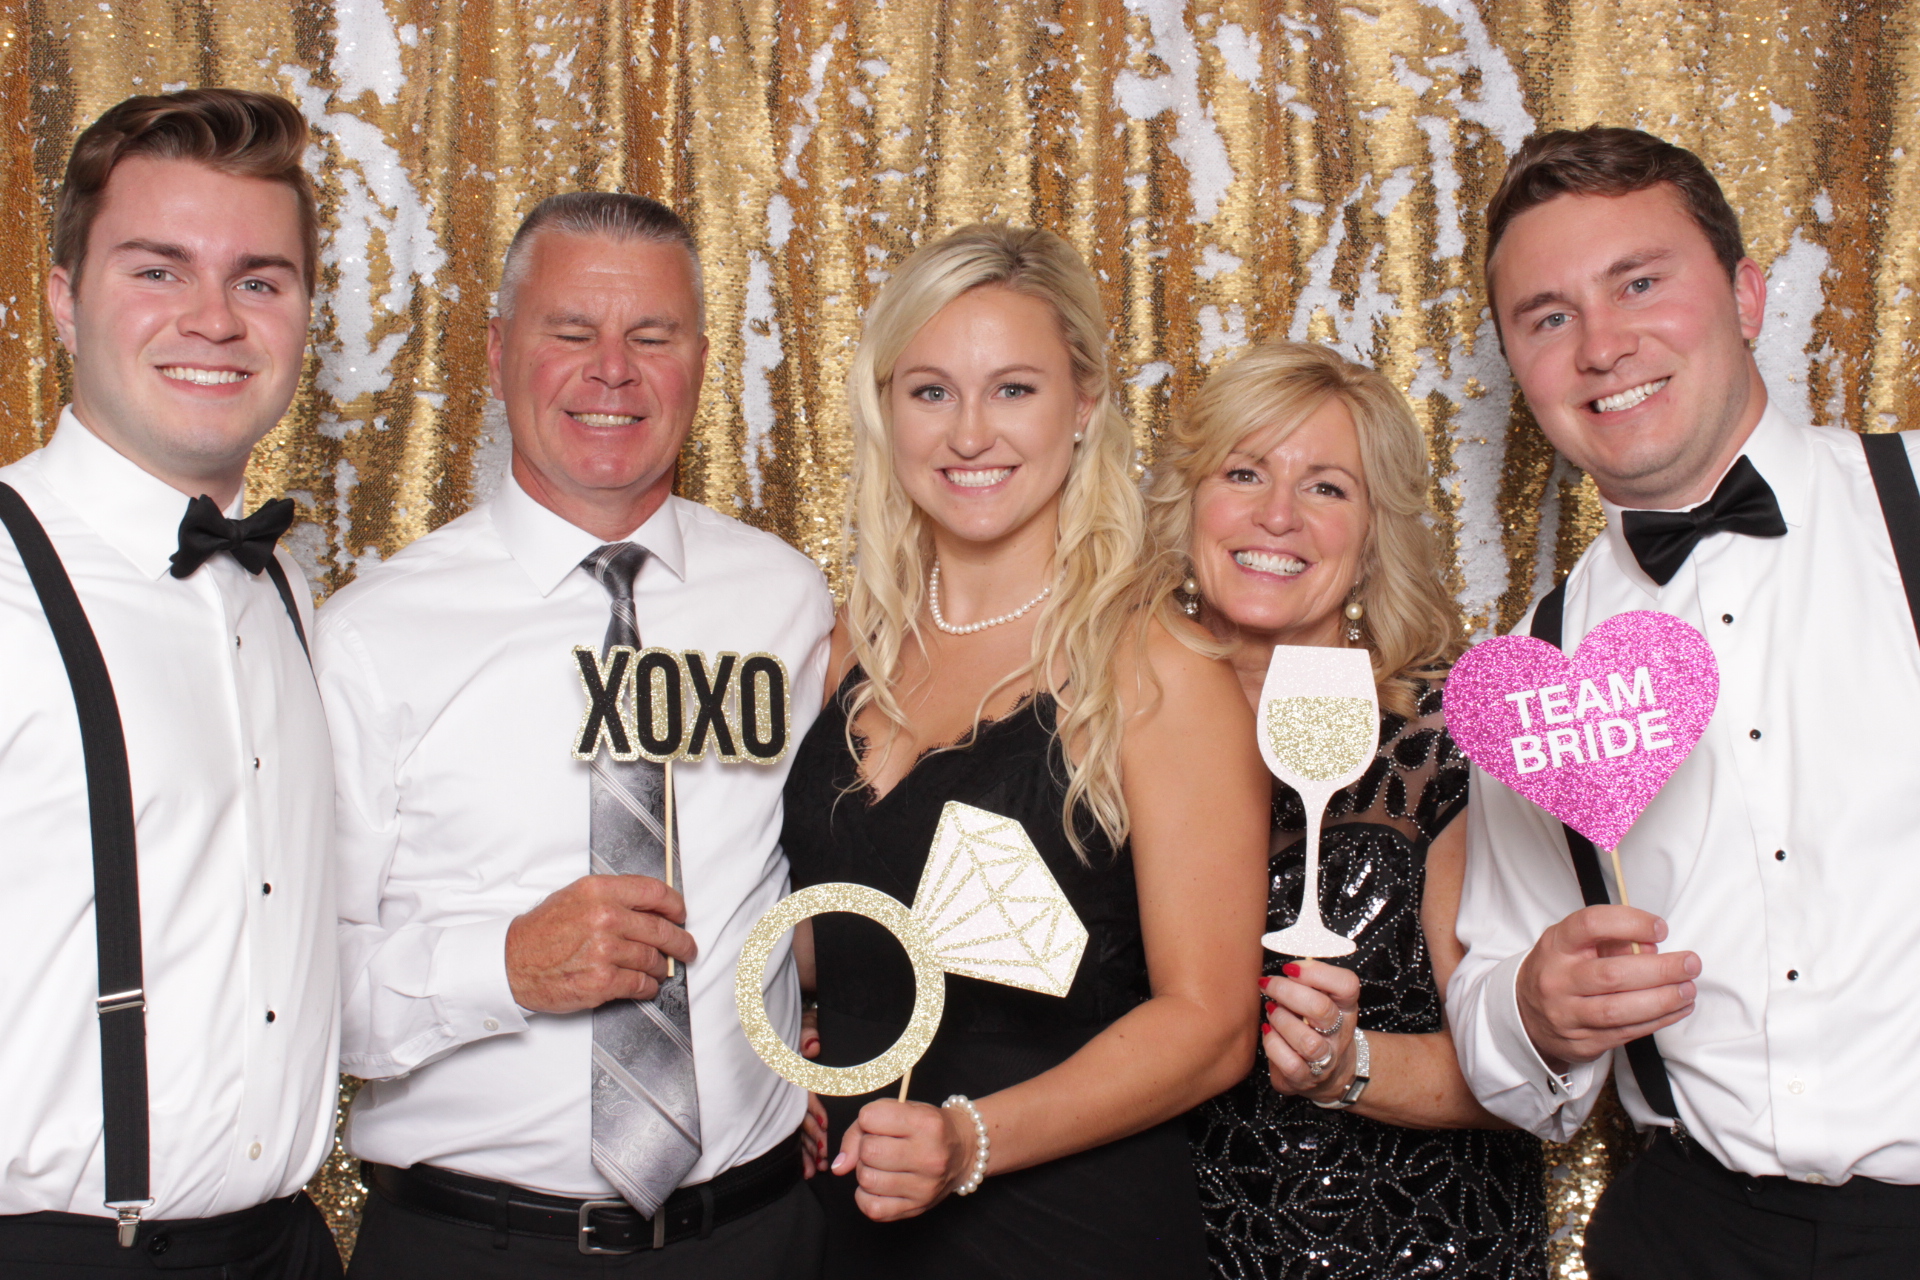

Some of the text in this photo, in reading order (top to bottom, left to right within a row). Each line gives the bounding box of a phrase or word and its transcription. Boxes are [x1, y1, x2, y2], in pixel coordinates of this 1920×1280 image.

[575, 650, 785, 758] XOXO
[1505, 667, 1656, 729] TEAM
[1511, 710, 1673, 775] BRIDE
